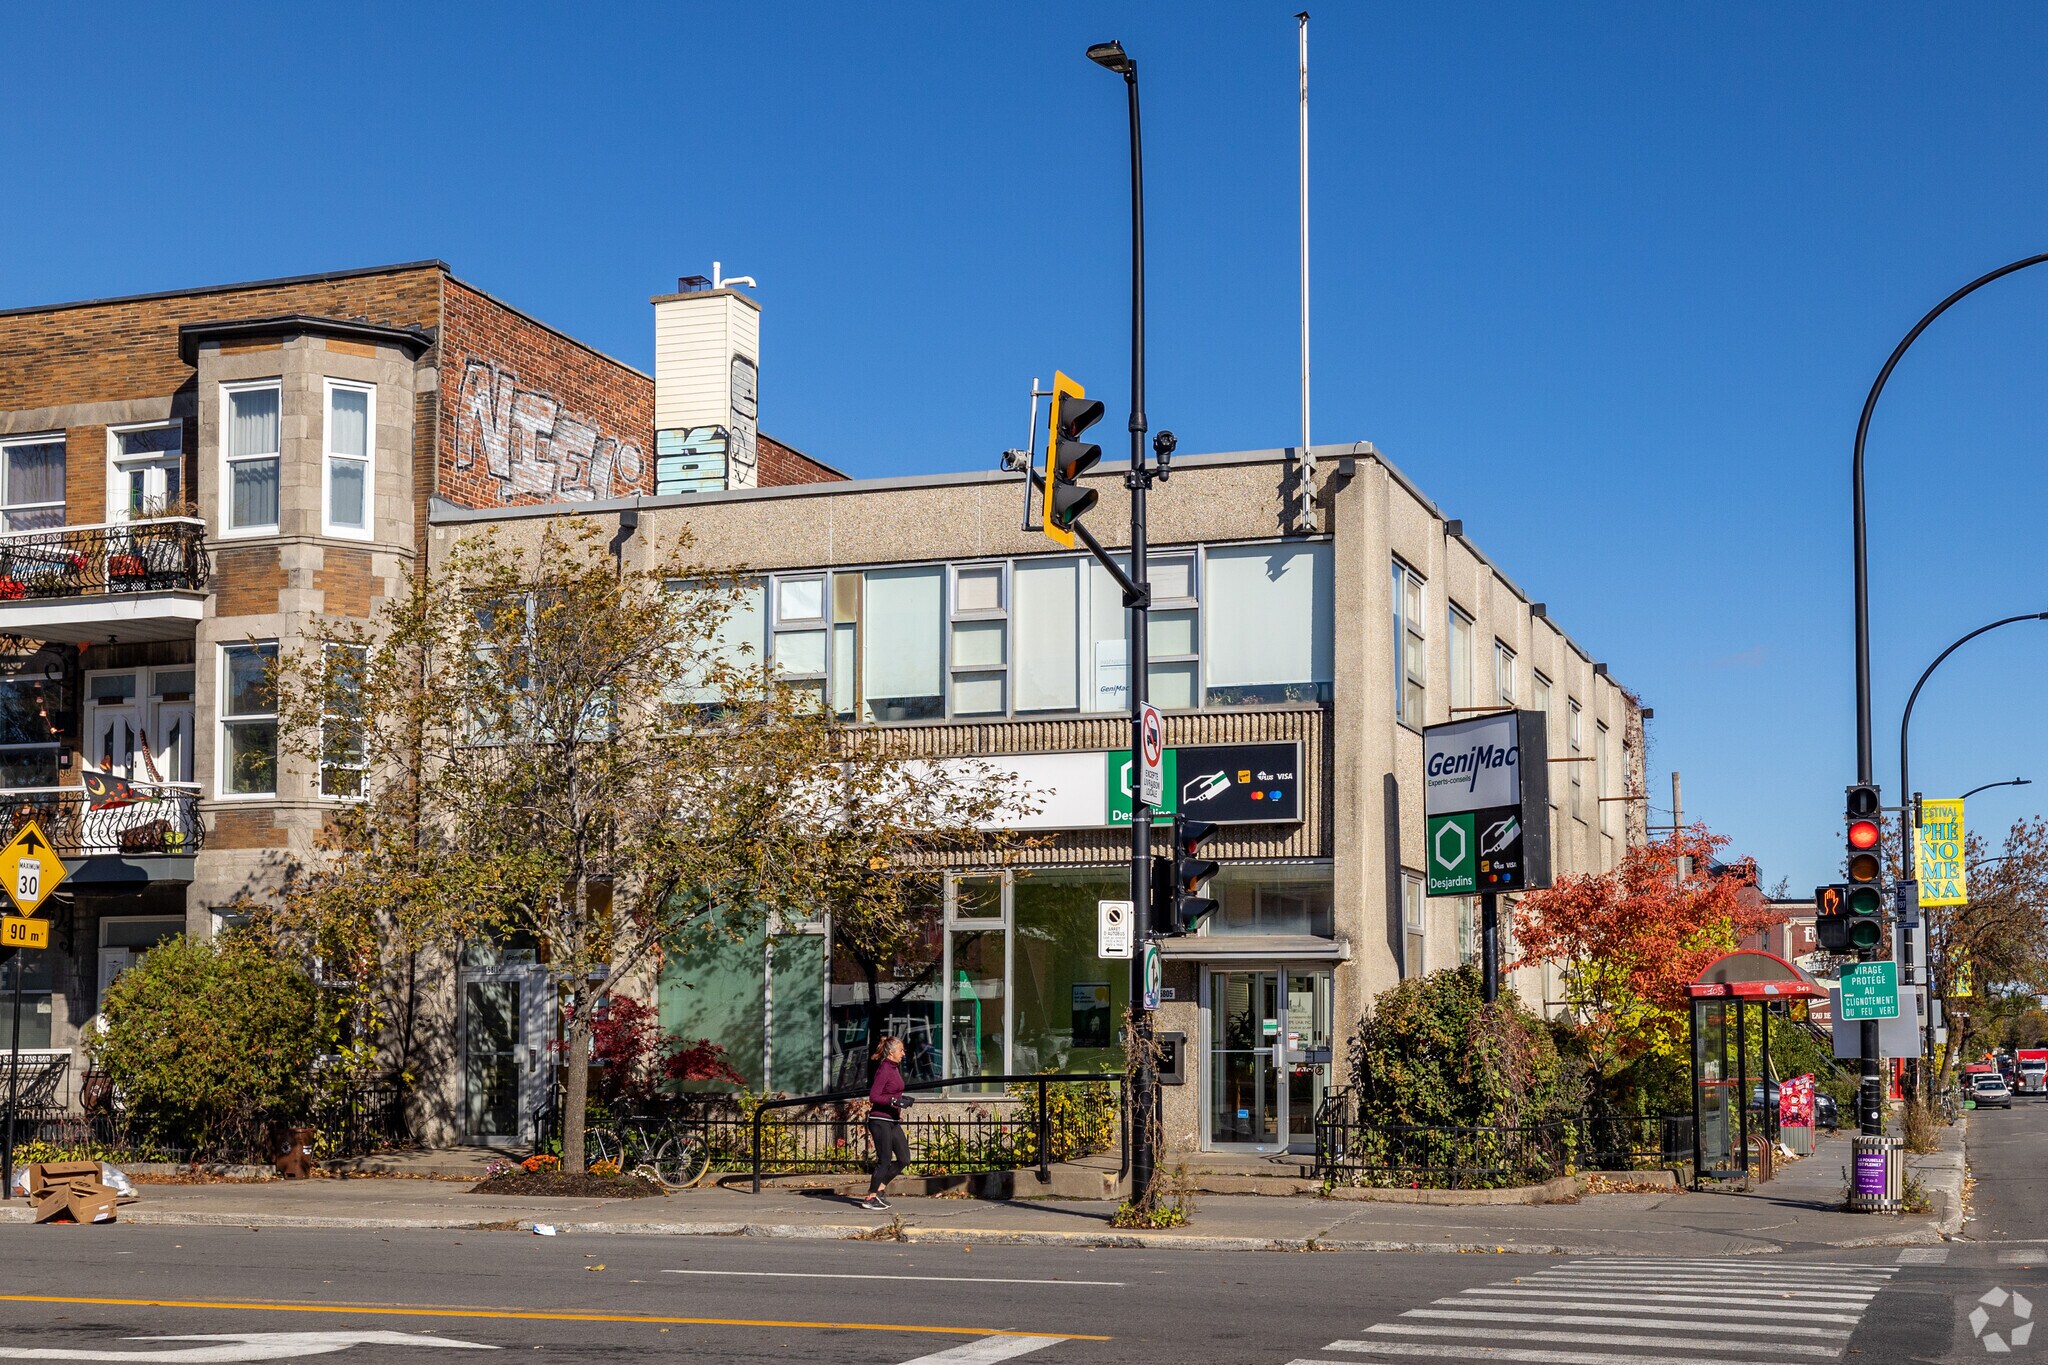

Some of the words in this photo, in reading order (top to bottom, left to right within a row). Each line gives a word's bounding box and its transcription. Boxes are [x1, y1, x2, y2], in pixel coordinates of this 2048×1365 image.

[1100, 685, 1130, 696] GeniMac
[1427, 744, 1519, 793] GeniMac
[1276, 772, 1293, 780] VISA
[1428, 774, 1472, 787] Experts-conseils
[1922, 806, 1959, 818] ESTIVAL
[1920, 842, 1959, 860] NO
[19, 862, 40, 870] MAXIMUM
[1921, 861, 1960, 880] ME
[19, 875, 38, 896] 30
[1430, 875, 1473, 890] Desjardins
[1922, 880, 1961, 899] NA
[10, 923, 26, 940] 90
[30, 932, 39, 941] m
[1855, 965, 1882, 975] VIRAGE
[1851, 973, 1886, 985] PROTÉGÉ
[1864, 986, 1875, 995] AU
[1845, 996, 1894, 1006] CLIGNOTEMENT
[1845, 1008, 1855, 1016] DU
[1861, 1007, 1873, 1016] FEU
[1879, 1006, 1895, 1015] VERT
